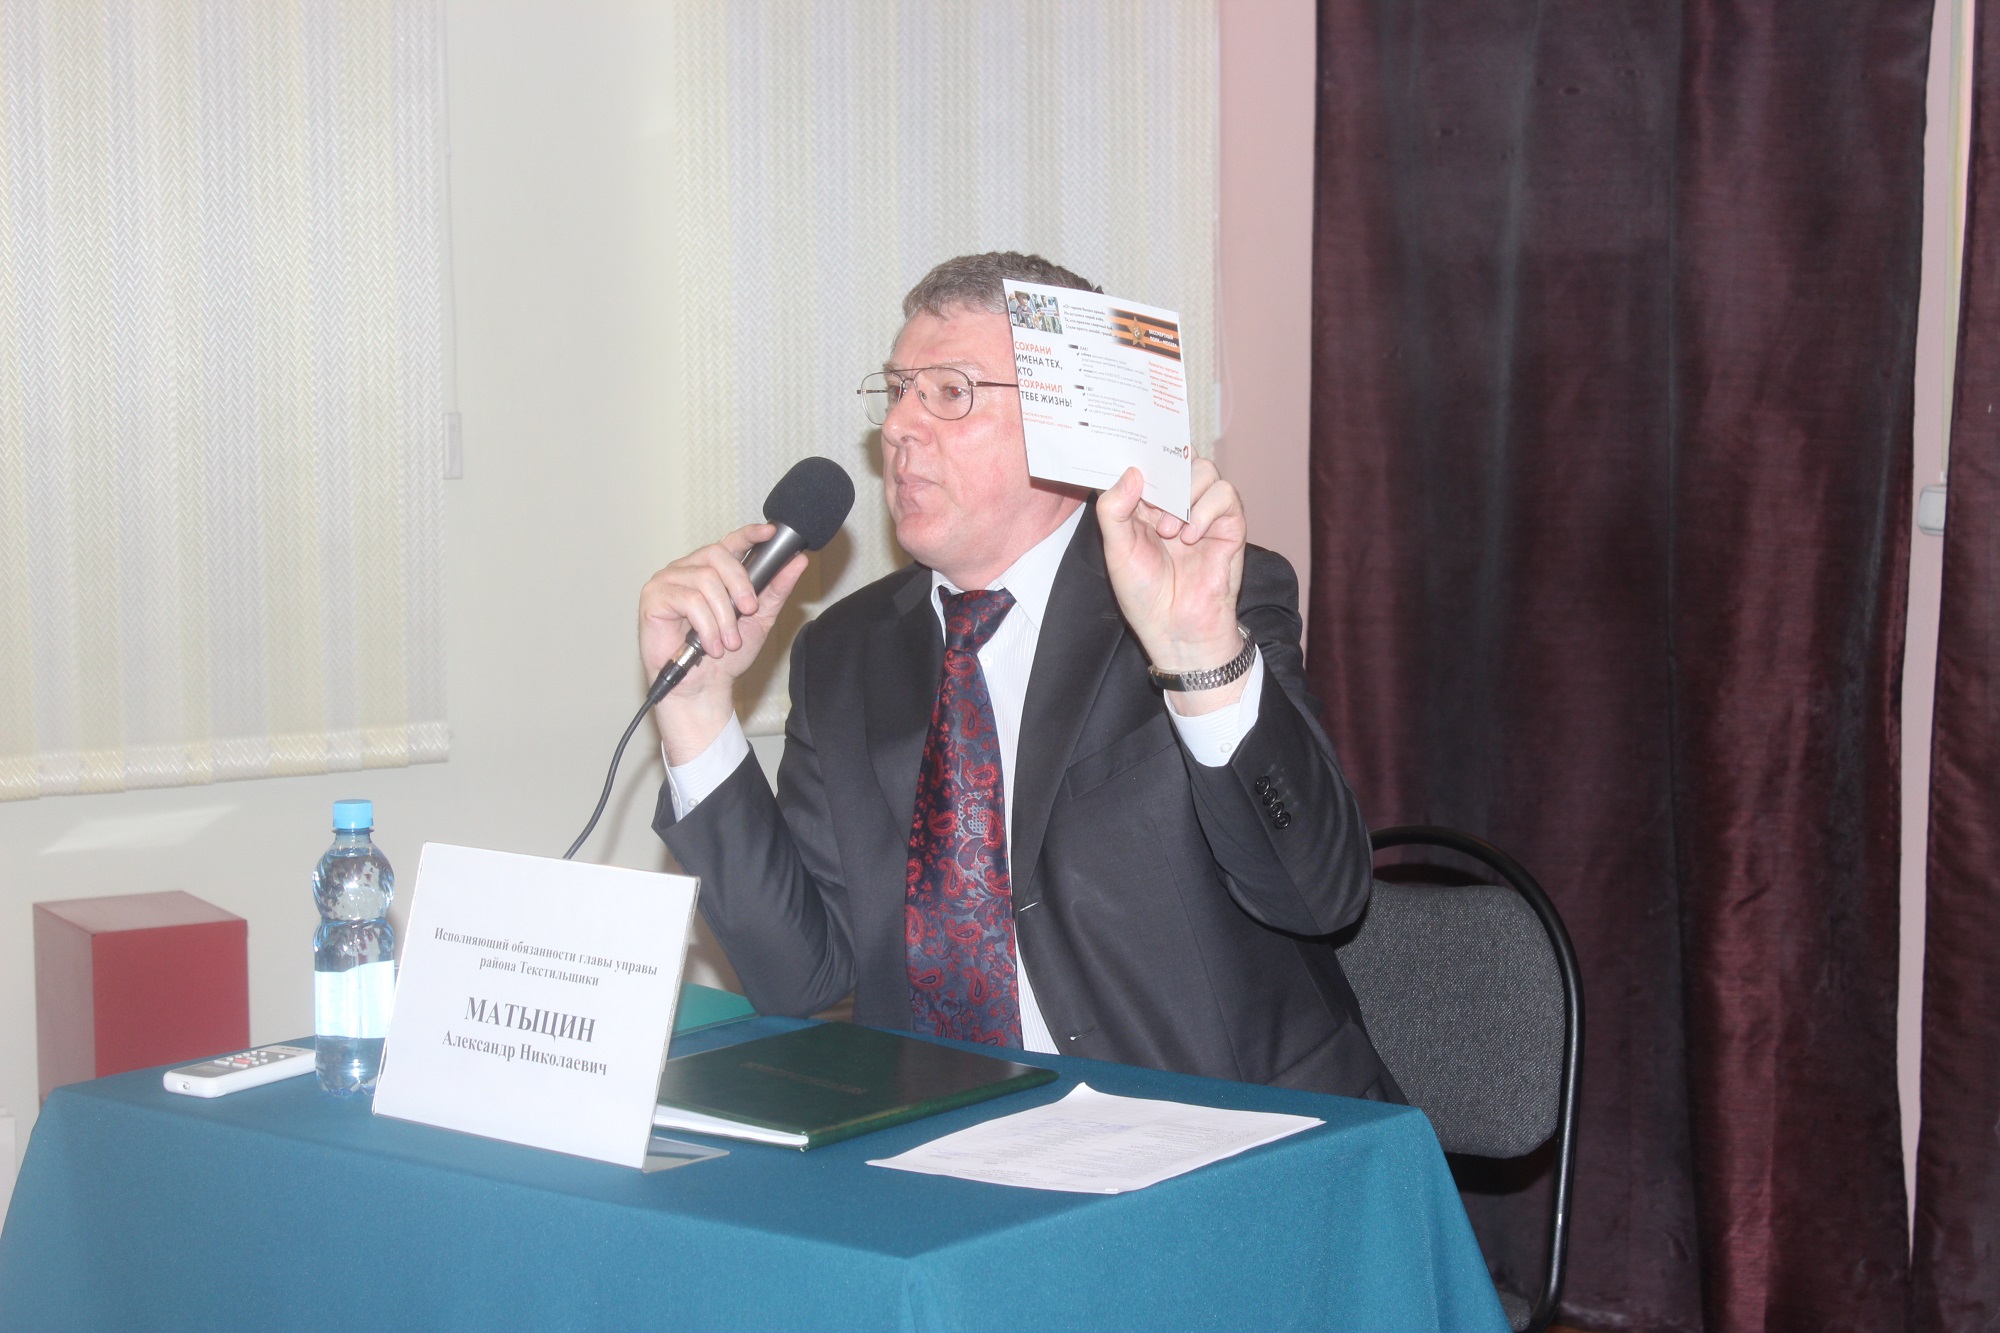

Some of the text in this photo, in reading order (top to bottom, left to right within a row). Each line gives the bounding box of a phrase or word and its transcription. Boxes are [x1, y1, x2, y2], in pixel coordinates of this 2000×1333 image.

[1014, 340, 1052, 355] СОХРАНИ
[1015, 353, 1063, 370] ИМЕНА ТЕХ,
[1017, 366, 1033, 377] КТО
[1018, 378, 1063, 394] СОХРАНИЛ
[1020, 390, 1039, 402] ТЕБЕ
[1040, 394, 1073, 408] ЖИЗНЬ!
[434, 926, 658, 976] Исполняющий обязанности главы управы
[478, 955, 600, 987] района Текстильщики
[464, 996, 597, 1043] МАТЫЦИН
[441, 1029, 608, 1076] Александр Николаевич
